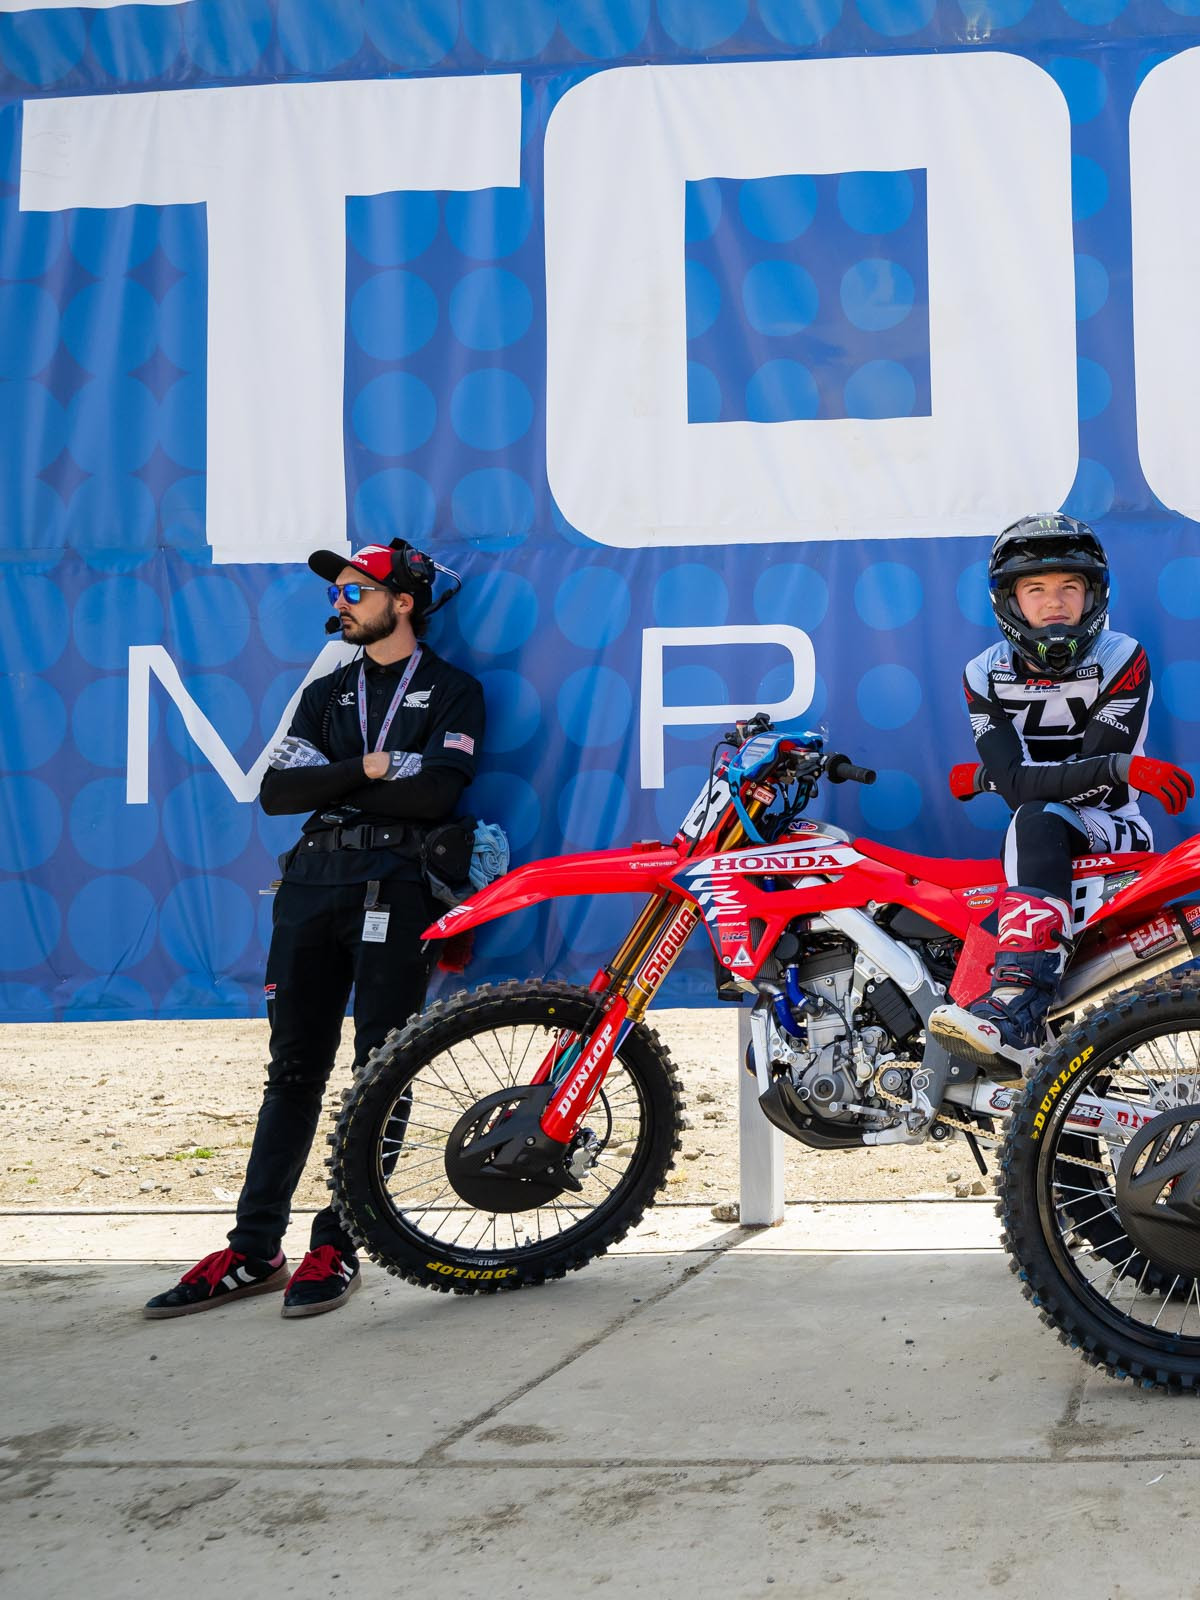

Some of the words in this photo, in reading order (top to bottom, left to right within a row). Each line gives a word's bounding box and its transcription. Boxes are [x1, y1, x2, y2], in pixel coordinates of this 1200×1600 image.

[711, 854, 842, 872] HONDA
[1072, 857, 1115, 870] NDA
[688, 876, 748, 922] CRF
[642, 907, 698, 990] SHOWA
[1130, 918, 1169, 951] ヨシムラ
[558, 1024, 613, 1118] DUNLOP
[1034, 1045, 1095, 1131] DUNLOP
[426, 1262, 510, 1280] DUNLOP
